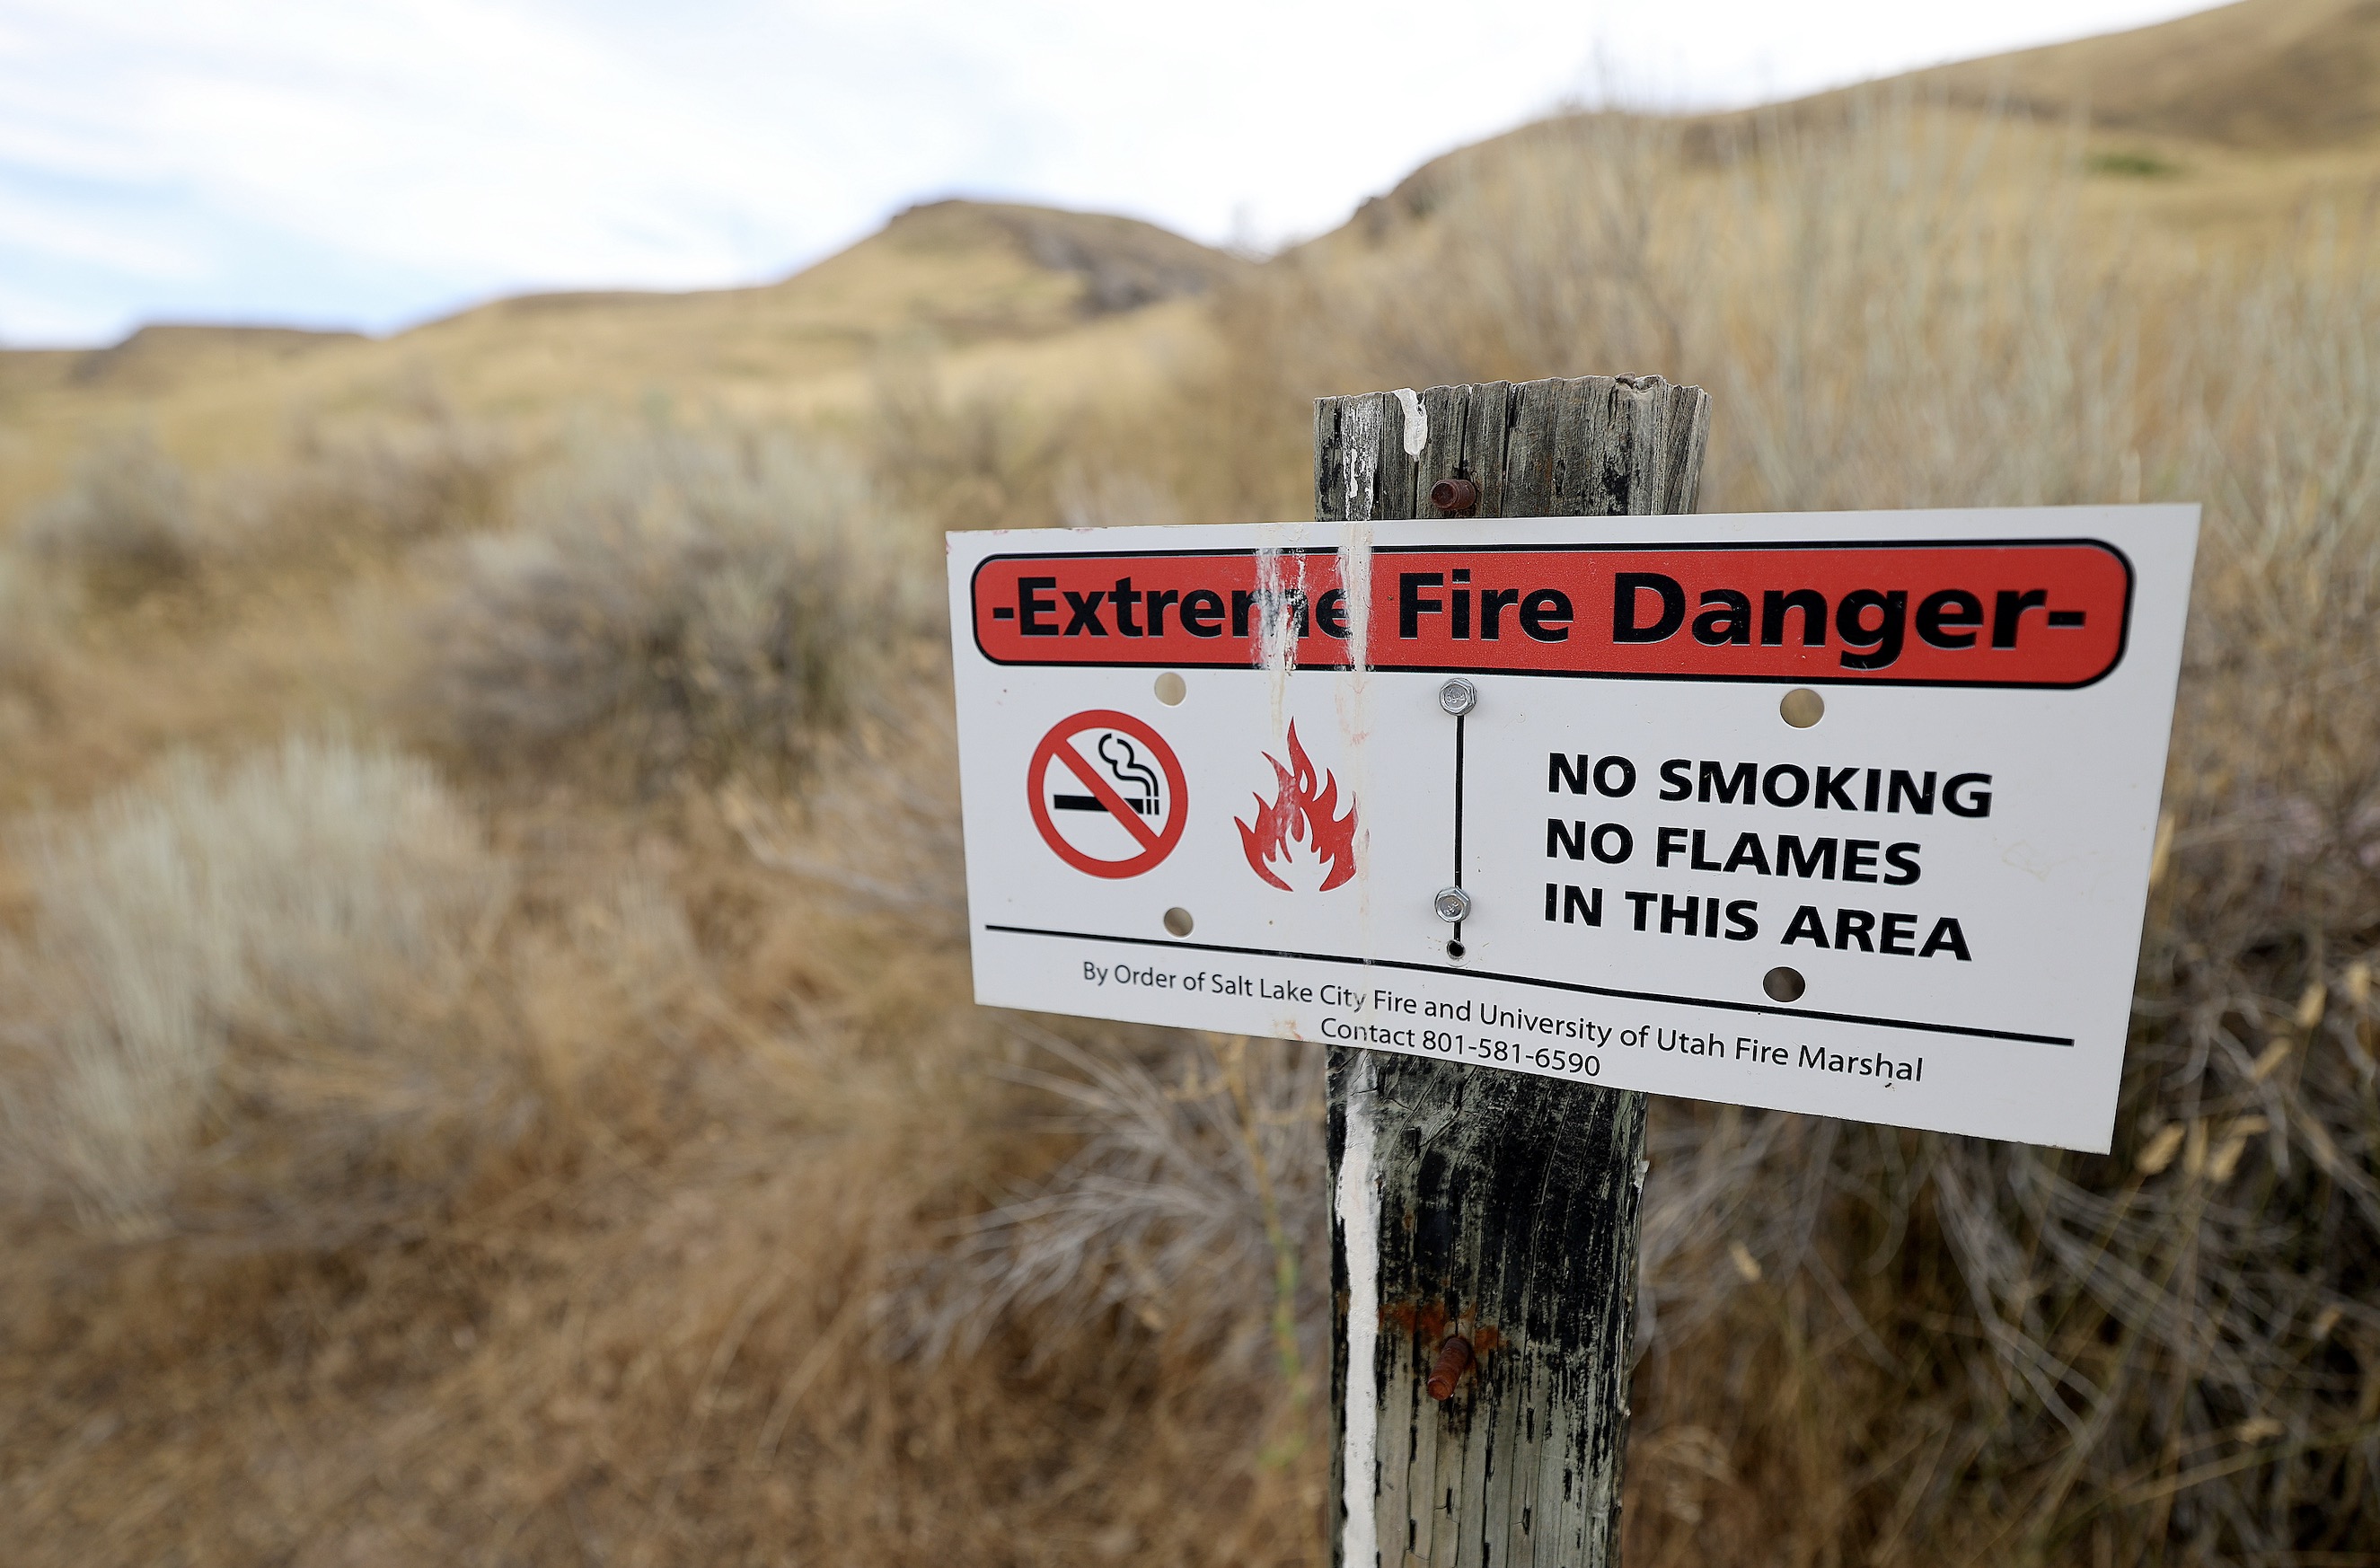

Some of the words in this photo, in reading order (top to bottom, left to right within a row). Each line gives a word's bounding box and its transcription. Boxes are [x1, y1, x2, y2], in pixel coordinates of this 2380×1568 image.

[992, 577, 1354, 639] -Extreme
[1398, 571, 1575, 642] Fire
[1613, 571, 2087, 670] Danger-
[1548, 752, 1636, 798] NO
[1659, 758, 1993, 818] SMOKING
[1547, 818, 1634, 865] NO
[1656, 826, 1921, 886] FLAMES
[1545, 883, 1603, 928] IN
[1625, 890, 1759, 941] THIS
[1780, 904, 1972, 962] AREA
[1083, 961, 1108, 987] By
[1114, 965, 1177, 990] Order
[1183, 972, 1206, 991] of
[1212, 973, 1254, 998] Salt
[1260, 978, 1314, 1004] Lake
[1319, 984, 1367, 1014] City
[1374, 990, 1418, 1015] Fire
[1424, 1000, 1471, 1023] and
[1480, 1002, 1614, 1050] University
[1619, 1024, 1652, 1048] of
[1657, 1027, 1725, 1058] Utah
[1735, 1036, 1790, 1067] Fire
[1798, 1044, 1923, 1083] Marshal
[1320, 1017, 1416, 1048] Contact
[1422, 1030, 1601, 1078] 801-581-6590
